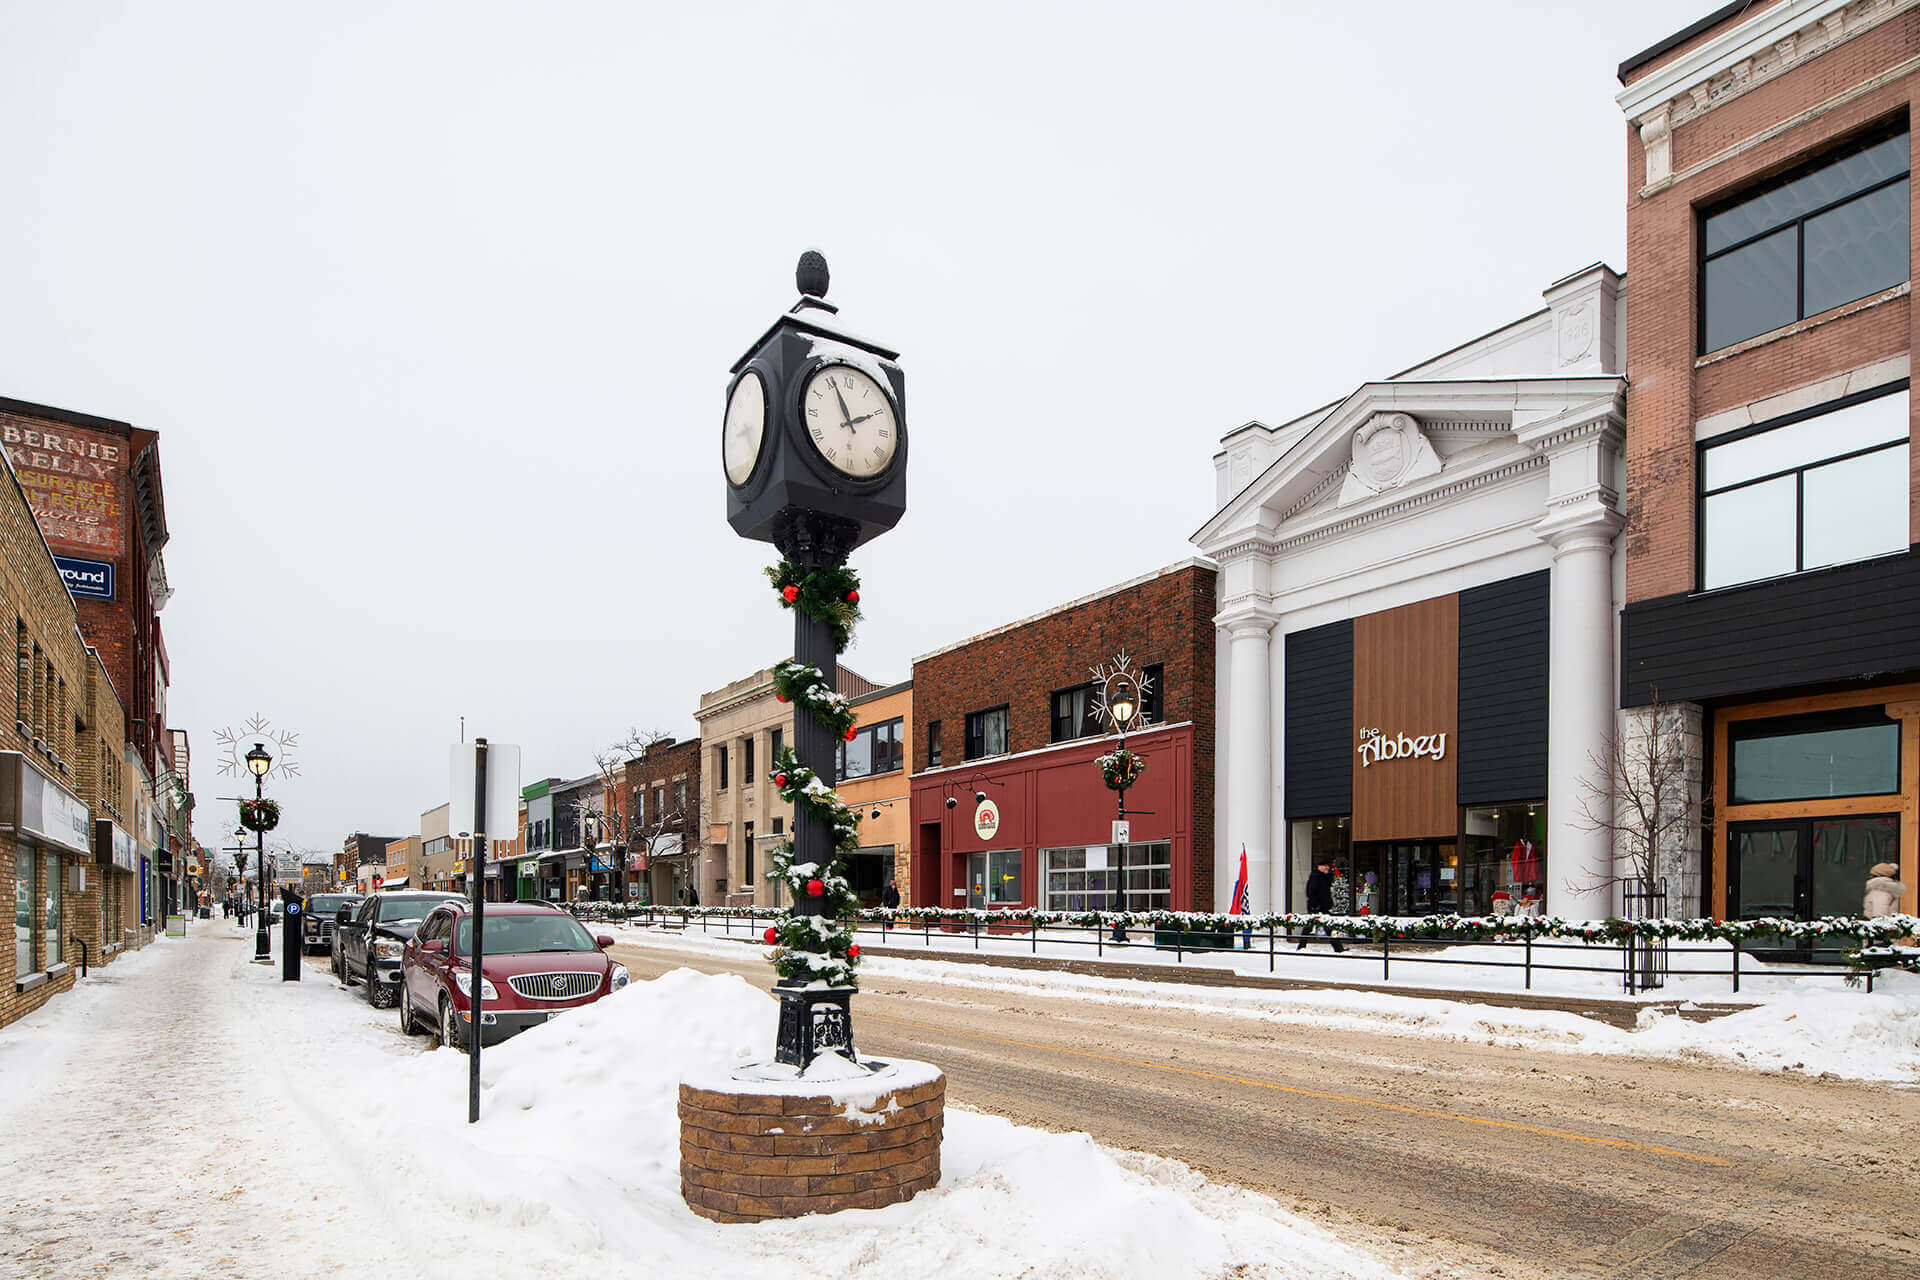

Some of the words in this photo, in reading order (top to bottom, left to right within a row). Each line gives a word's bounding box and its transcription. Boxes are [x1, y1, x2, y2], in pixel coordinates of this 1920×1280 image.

[3, 425, 119, 463] BERNIE
[5, 446, 116, 480] KELLY
[15, 469, 114, 497] NSURANCE
[1357, 731, 1447, 768] Abbey
[1359, 727, 1380, 740] the
